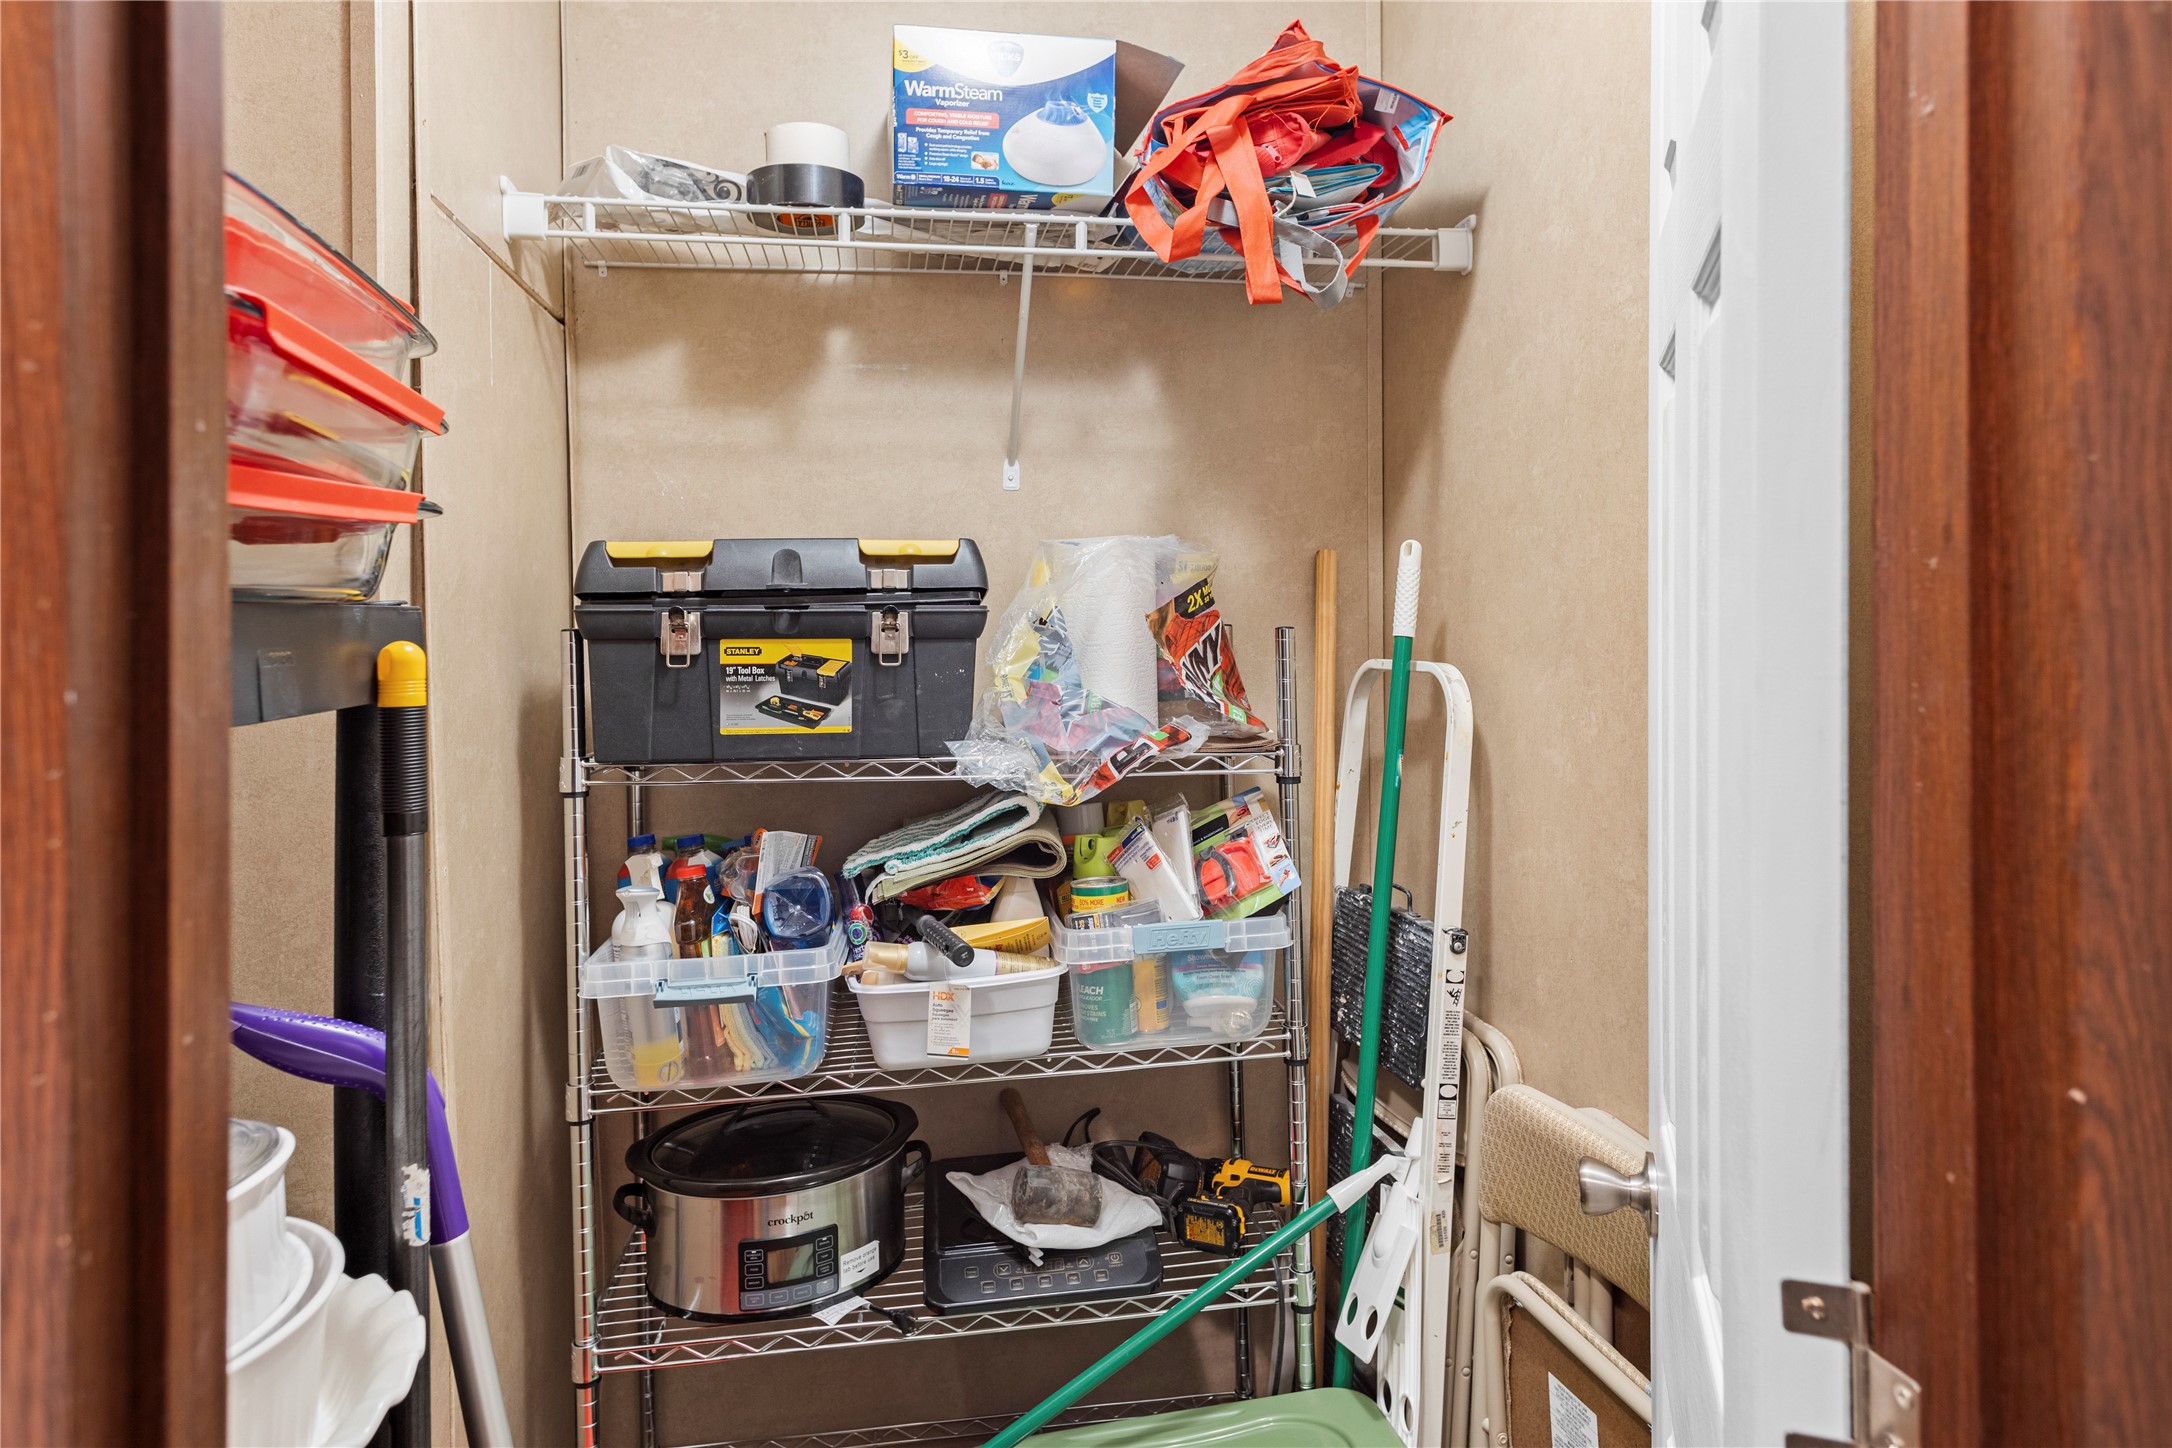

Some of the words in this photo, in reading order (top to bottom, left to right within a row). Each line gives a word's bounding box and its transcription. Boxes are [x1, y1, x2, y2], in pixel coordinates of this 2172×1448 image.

[904, 80, 1002, 102] WarmSteam
[935, 98, 970, 108] Vaporizer
[937, 128, 963, 136] Temporary
[1186, 589, 1203, 614] 2X
[726, 666, 736, 674] 19"
[738, 666, 751, 674] Tool
[752, 666, 765, 674] Box
[1152, 929, 1206, 948] Hefty
[1080, 985, 1104, 995] EACH
[932, 991, 955, 1001] HDX
[767, 1211, 814, 1226] crockpot
[842, 1256, 862, 1266] Remove
